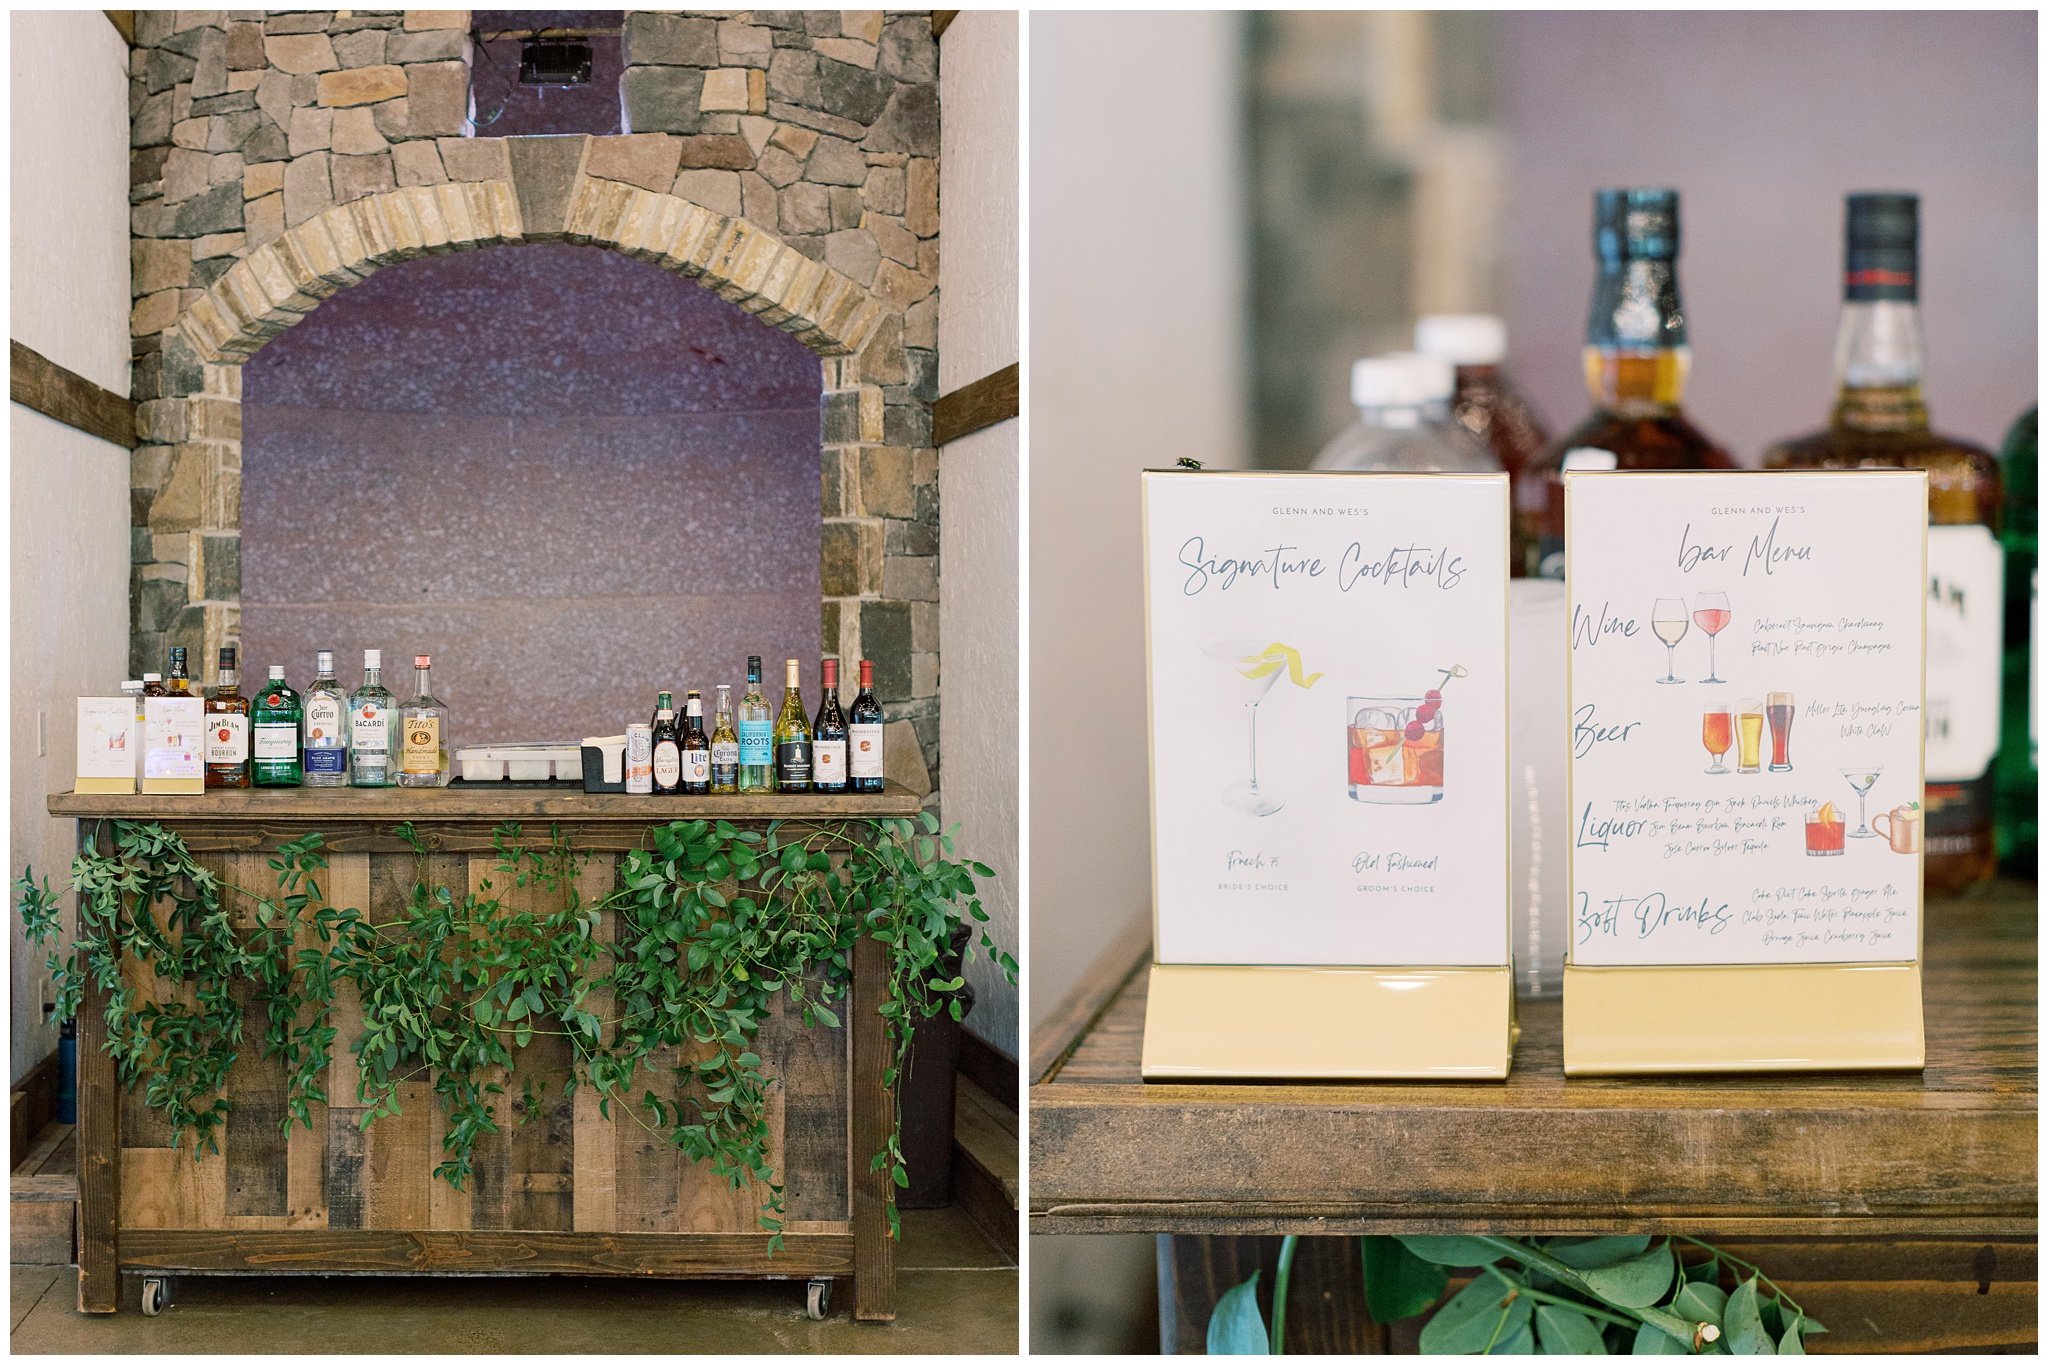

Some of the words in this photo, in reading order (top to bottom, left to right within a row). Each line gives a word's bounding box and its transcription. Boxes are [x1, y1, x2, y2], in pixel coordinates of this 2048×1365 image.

[1272, 507, 1309, 516] GLENN
[1312, 507, 1334, 516] AND
[1338, 507, 1369, 516] WES'S
[1711, 507, 1746, 515] GLENN
[1750, 506, 1772, 515] AND
[1775, 506, 1806, 514] WES'S
[1743, 516, 1811, 577] Menu
[1178, 536, 1326, 596] Signature
[1338, 541, 1467, 592] Cocktails
[1572, 601, 1640, 650] Wine
[1753, 617, 1793, 634] Cabernet
[1848, 639, 1892, 655] Champagne
[311, 709, 334, 720] Cuervo
[209, 721, 221, 732] JIM
[222, 719, 239, 731] BEAM
[1574, 704, 1641, 759] Beer
[1840, 724, 1864, 738] White
[259, 737, 292, 746] Tanqueray
[691, 753, 707, 764] Lite
[714, 749, 737, 757] Corona
[1577, 801, 1647, 852] Liquor
[1351, 851, 1380, 873] Old
[1386, 852, 1438, 873] Fashioned
[1255, 883, 1289, 891] CHOICE
[1634, 892, 1733, 939] Drinks
